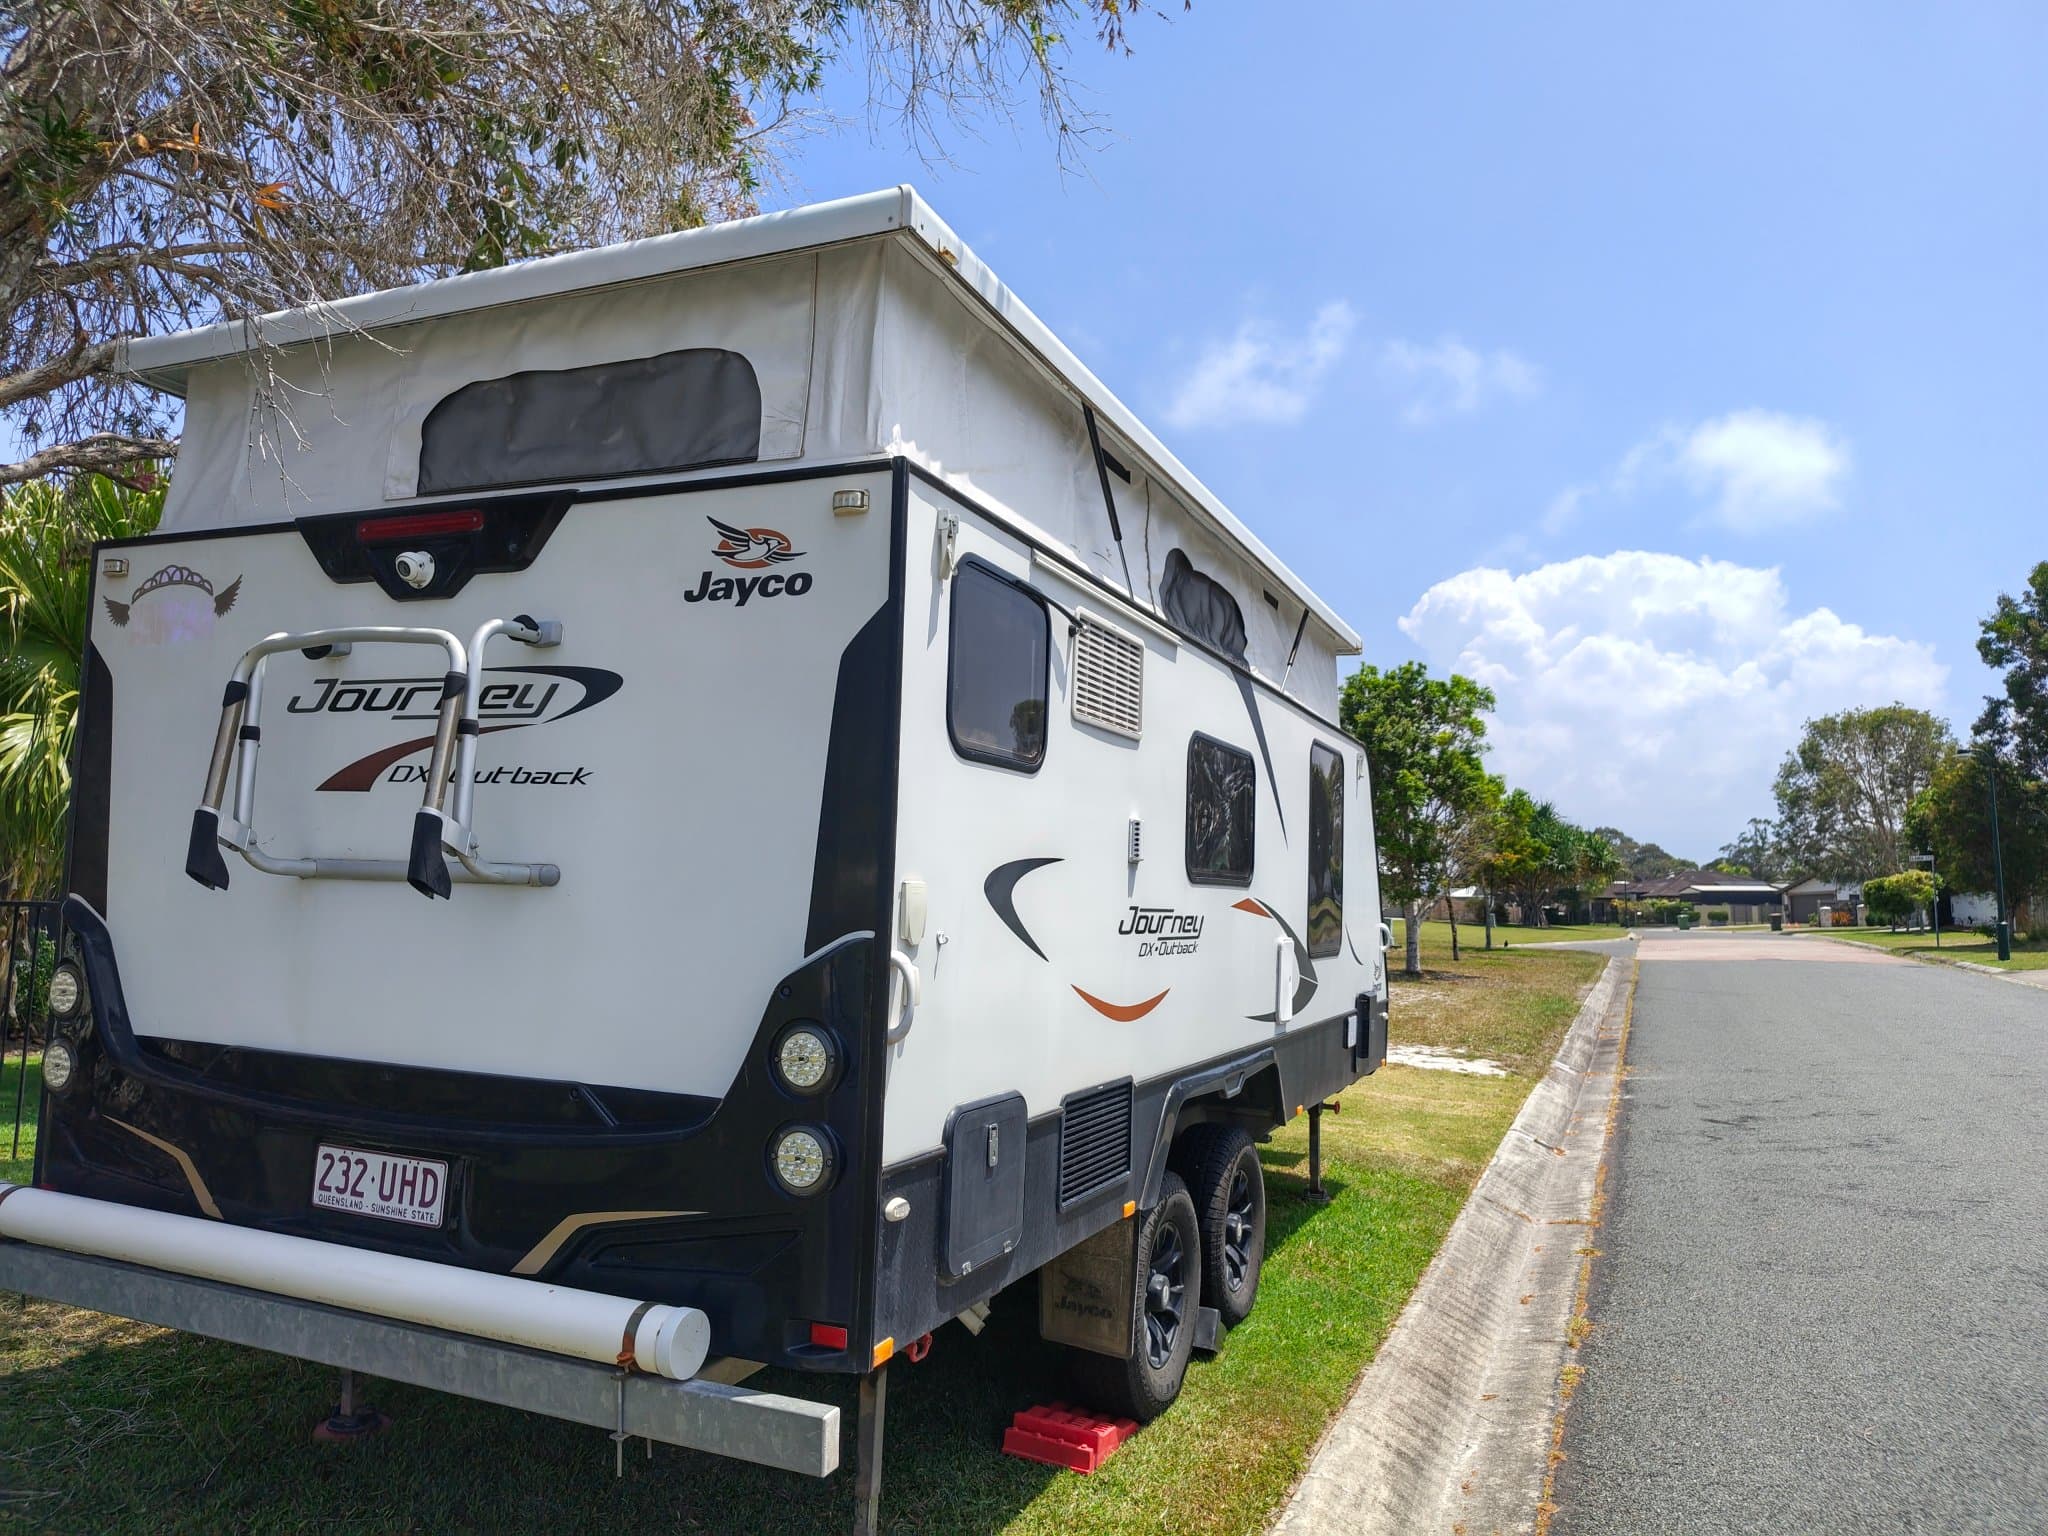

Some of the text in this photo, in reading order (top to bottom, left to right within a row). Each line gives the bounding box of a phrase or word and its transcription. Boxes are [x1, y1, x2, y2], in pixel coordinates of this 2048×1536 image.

[683, 571, 813, 607] Jayco
[286, 677, 560, 721] Jourey
[449, 766, 593, 786] utback
[1118, 906, 1204, 941] Journey
[318, 1193, 435, 1223] QUEENSLAND SUNSHINE STATE
